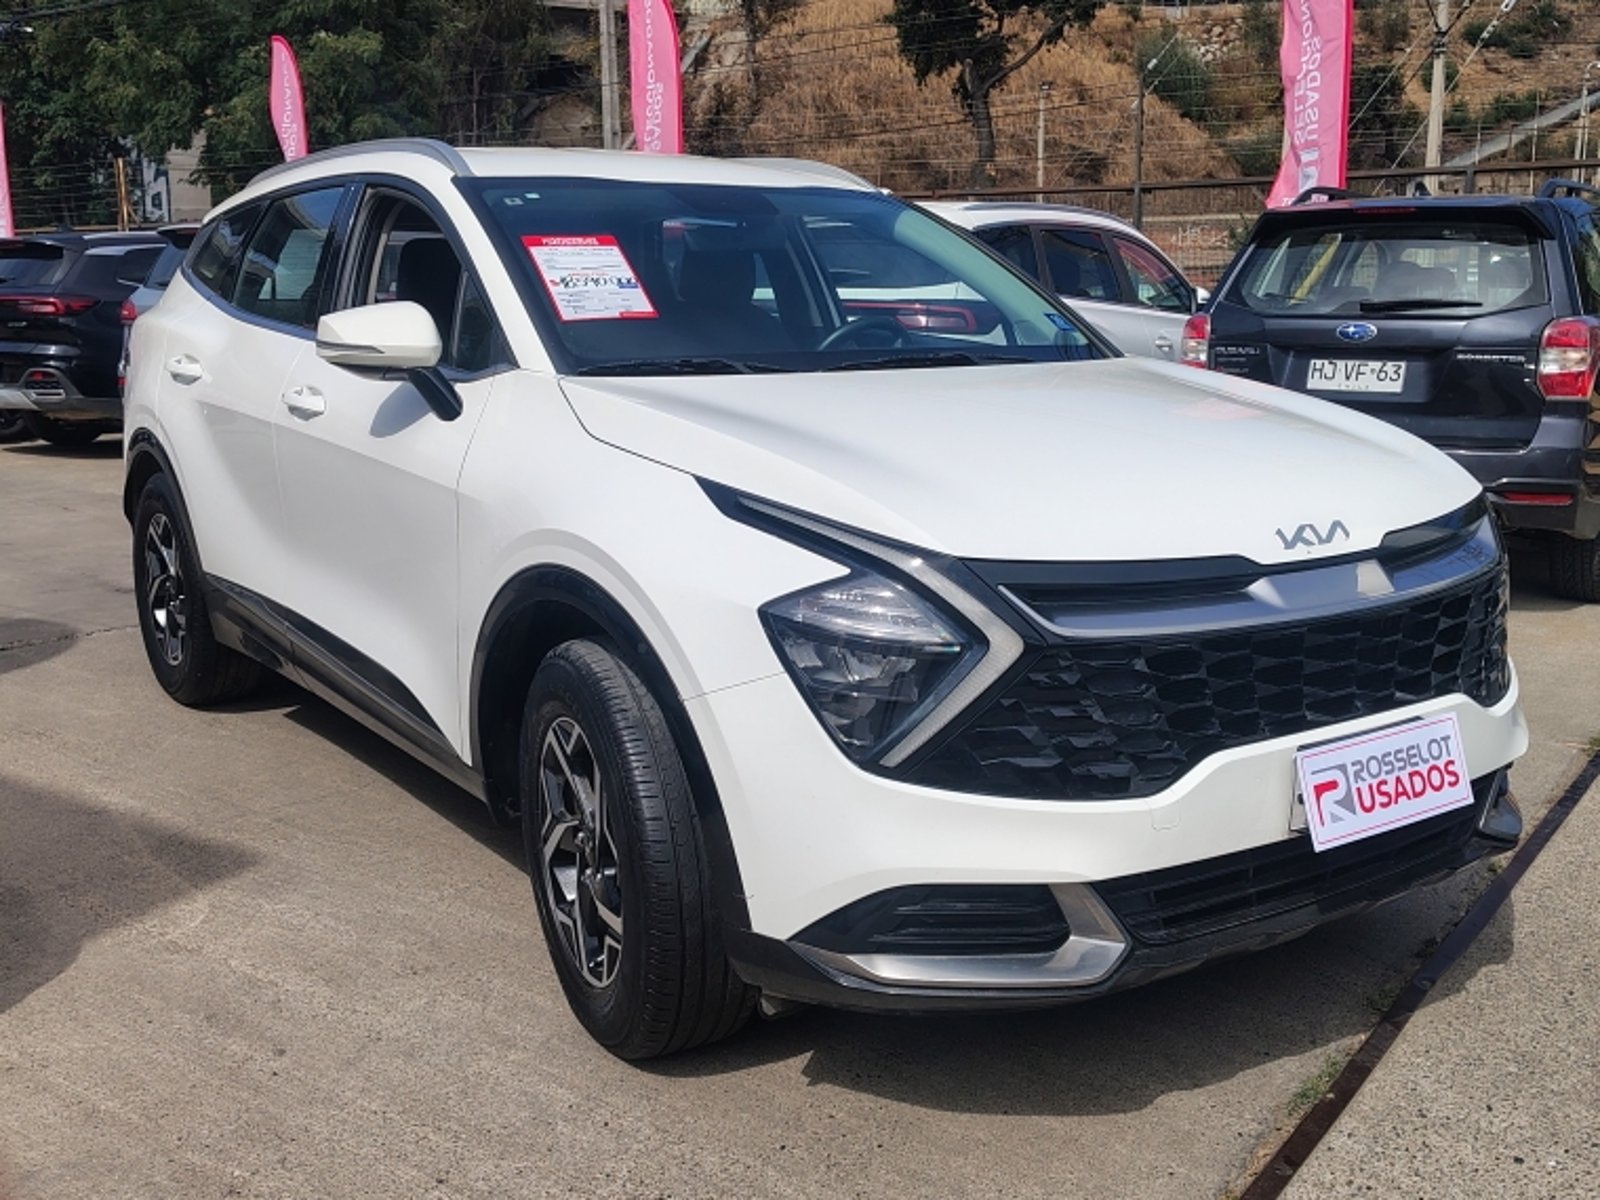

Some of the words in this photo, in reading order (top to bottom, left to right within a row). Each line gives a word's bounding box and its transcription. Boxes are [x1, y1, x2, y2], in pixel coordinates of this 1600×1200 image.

[1275, 519, 1350, 550] KIA
[1351, 735, 1452, 784] ROSSELOT
[1355, 760, 1460, 813] USADOS
